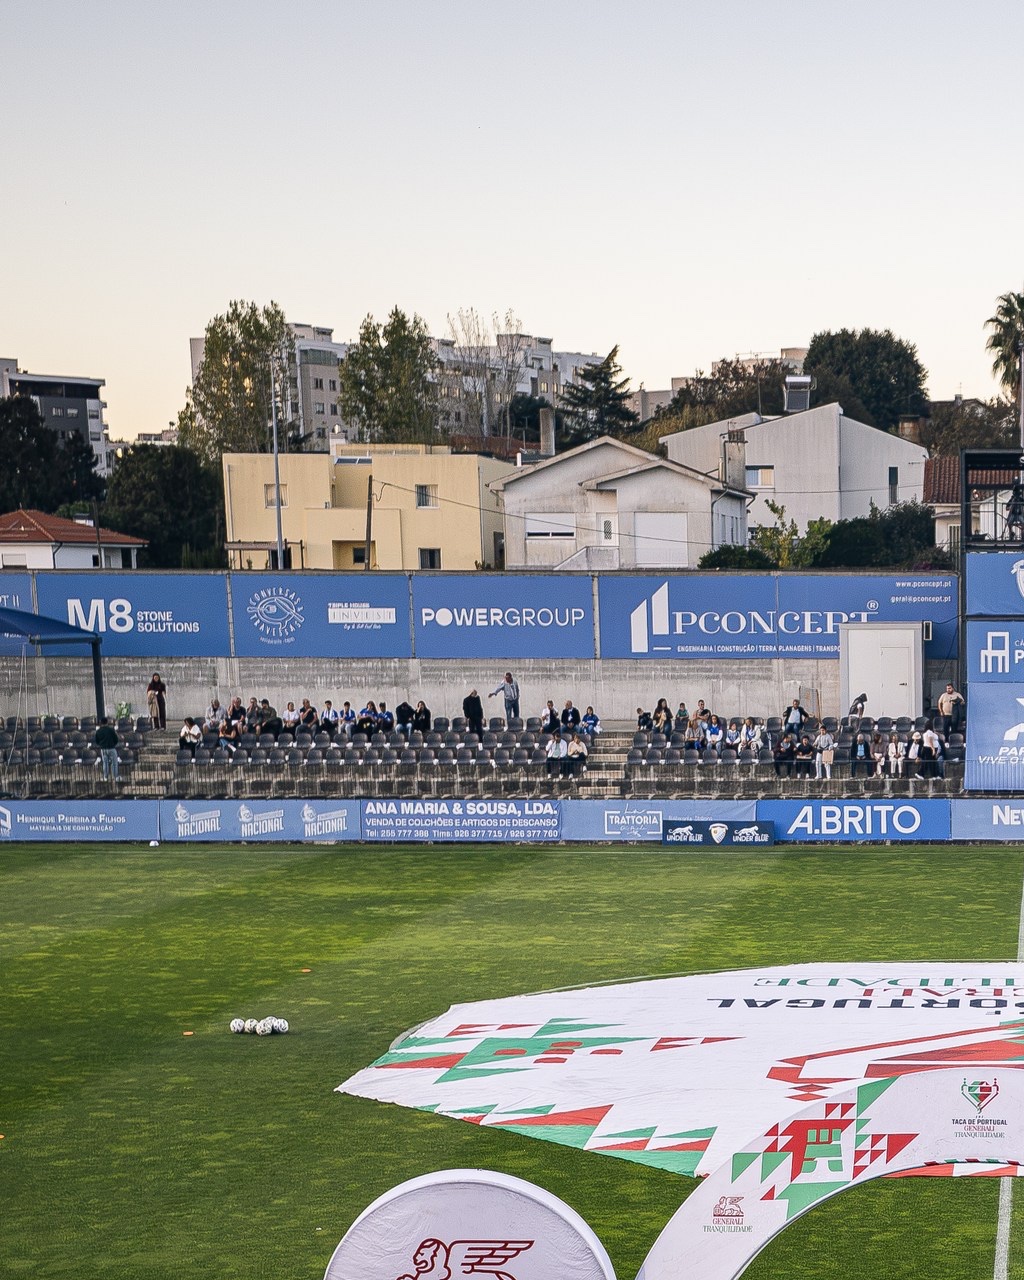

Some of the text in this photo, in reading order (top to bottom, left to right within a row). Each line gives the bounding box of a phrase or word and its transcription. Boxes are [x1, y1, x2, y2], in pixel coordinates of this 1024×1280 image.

[895, 580, 952, 588] www.pconcept.pt
[67, 598, 134, 633] M8
[137, 611, 173, 621] STONE
[421, 607, 585, 627] POWERGROUP
[137, 622, 200, 633] SOLUTIONS
[677, 645, 713, 653] ENGENHARIA
[717, 644, 755, 653] CONSTRUÇÃO
[978, 755, 1006, 765] VIVE
[1010, 756, 1018, 764] O
[365, 802, 558, 817] ANA MARIA & SOUSA, LDA.
[366, 818, 395, 826] VENDA
[396, 818, 407, 826] DE
[408, 816, 453, 827] COLCHÕES
[462, 818, 498, 827] ARTIGOS
[500, 818, 511, 827] DE
[512, 818, 558, 827] DESCANSO
[609, 815, 659, 825] TRATTORIA
[787, 805, 921, 834] A.BRITO
[178, 817, 221, 837] NACIONAL
[241, 817, 285, 837] NACIONAL
[304, 817, 348, 837] NACIONAL
[366, 829, 379, 837] Tel:
[397, 829, 412, 837] 777
[471, 829, 486, 838] 377
[527, 829, 541, 838] 377
[666, 834, 687, 842] UNDER
[732, 834, 754, 842] UNDER
[703, 1225, 754, 1234] TRANQUILIDADE
